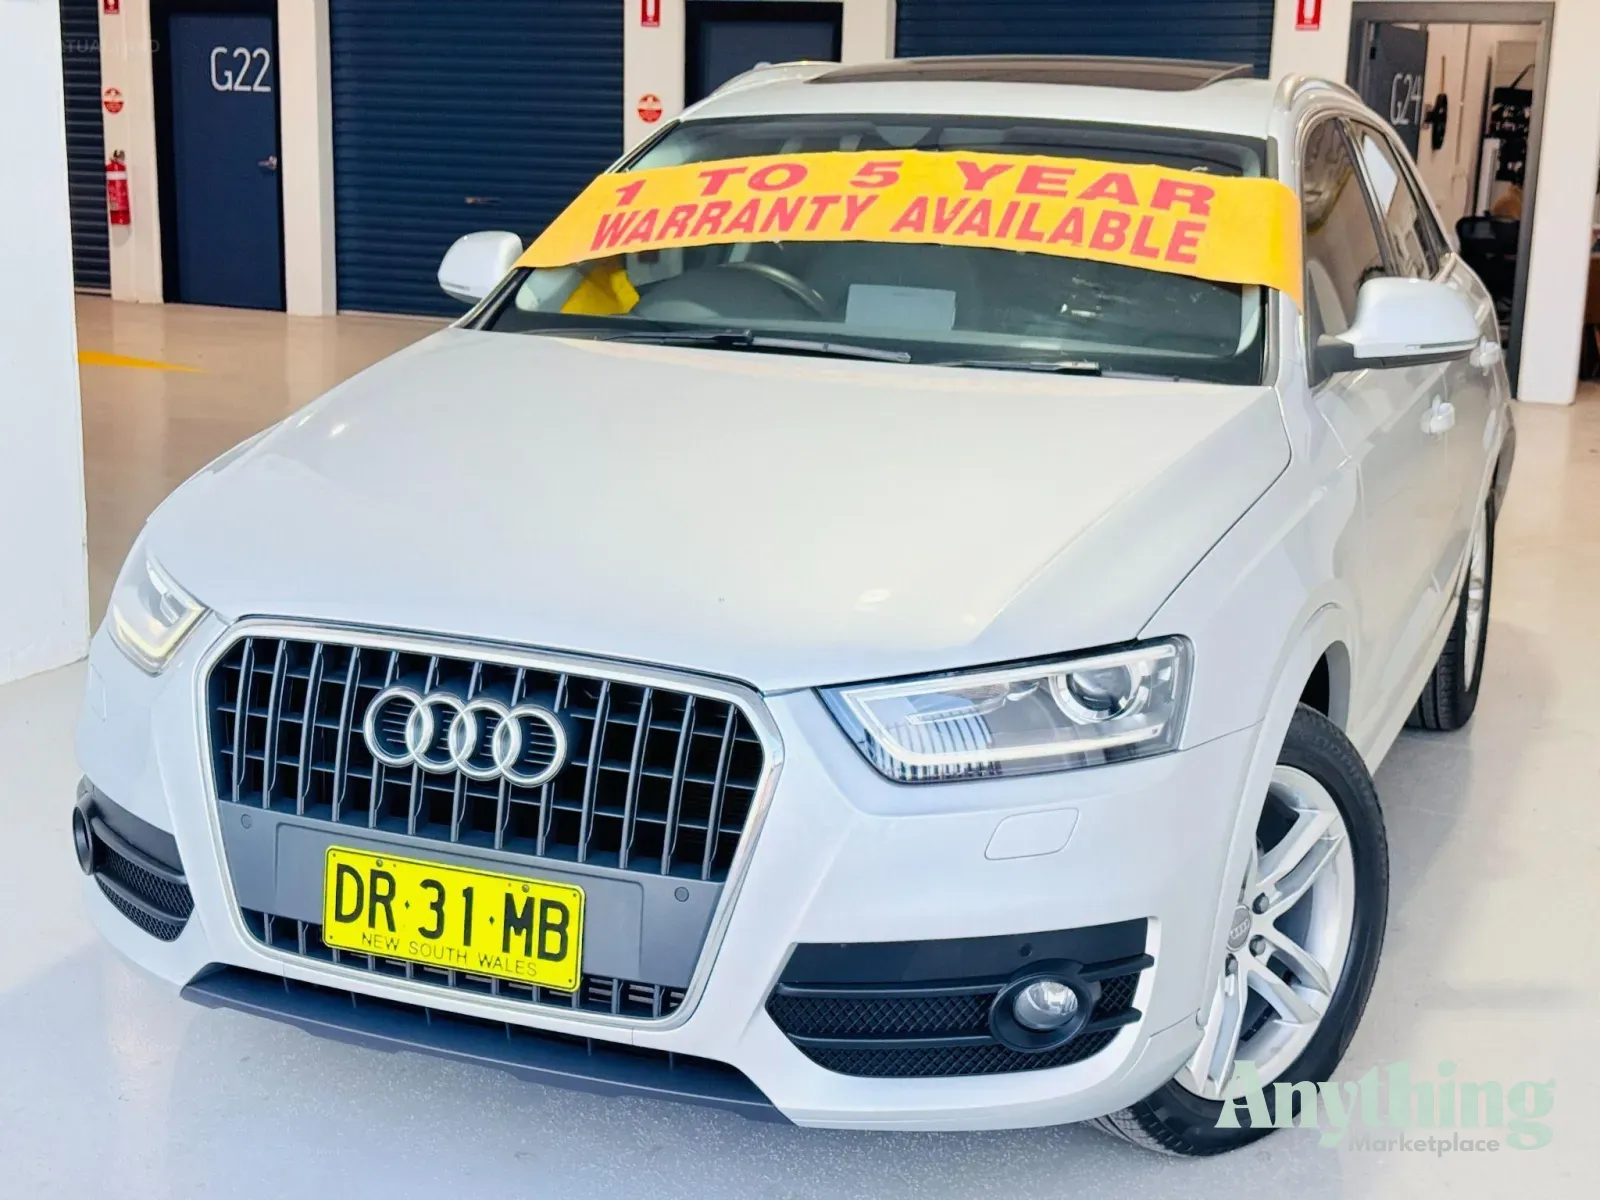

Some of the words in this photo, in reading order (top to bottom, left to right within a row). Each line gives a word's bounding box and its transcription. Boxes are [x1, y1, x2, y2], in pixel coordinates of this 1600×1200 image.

[210, 47, 271, 92] G22
[1390, 73, 1421, 125] G24
[615, 180, 646, 207] 1
[698, 163, 809, 196] TO
[850, 161, 904, 189] 5
[956, 160, 1215, 216] YEAR
[590, 194, 880, 251] WARRANTY
[890, 196, 1206, 264] AVAILABLE
[361, 932, 400, 951] NEW
[408, 941, 467, 965] SOUTH
[478, 953, 537, 977] WALES
